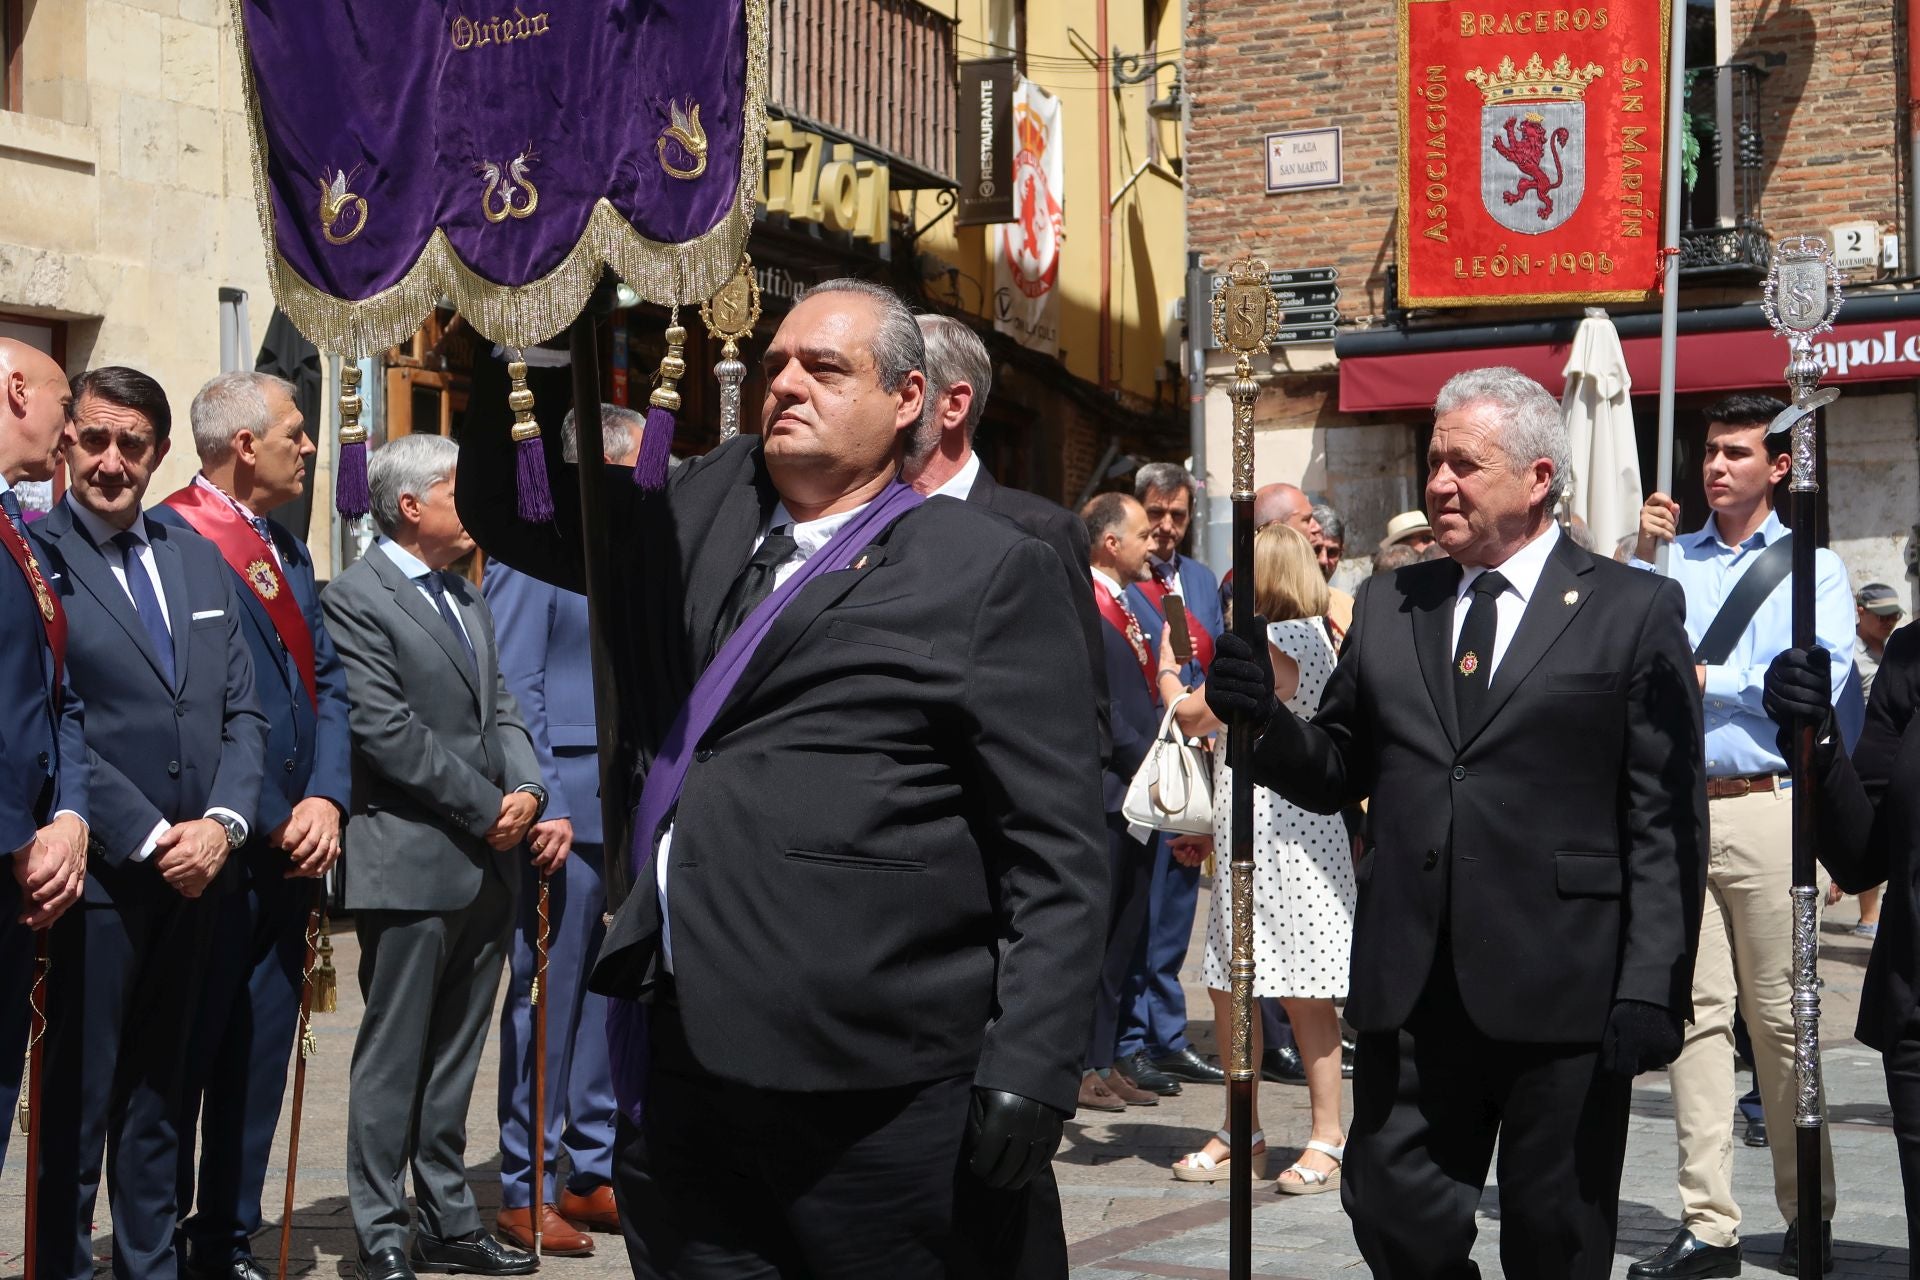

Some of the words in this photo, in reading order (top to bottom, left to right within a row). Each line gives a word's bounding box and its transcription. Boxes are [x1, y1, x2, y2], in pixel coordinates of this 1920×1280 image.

[1460, 8, 1608, 37] BRACEROS
[1621, 57, 1649, 113] SAN
[981, 80, 993, 179] RESTAURANTE
[1292, 142, 1317, 153] PLAZA
[1417, 65, 1448, 243] ASOCIACIÓN
[756, 119, 889, 243] izón
[1280, 163, 1295, 175] SAN
[1621, 126, 1654, 238] MARTÍN
[1847, 230, 1861, 252] 2
